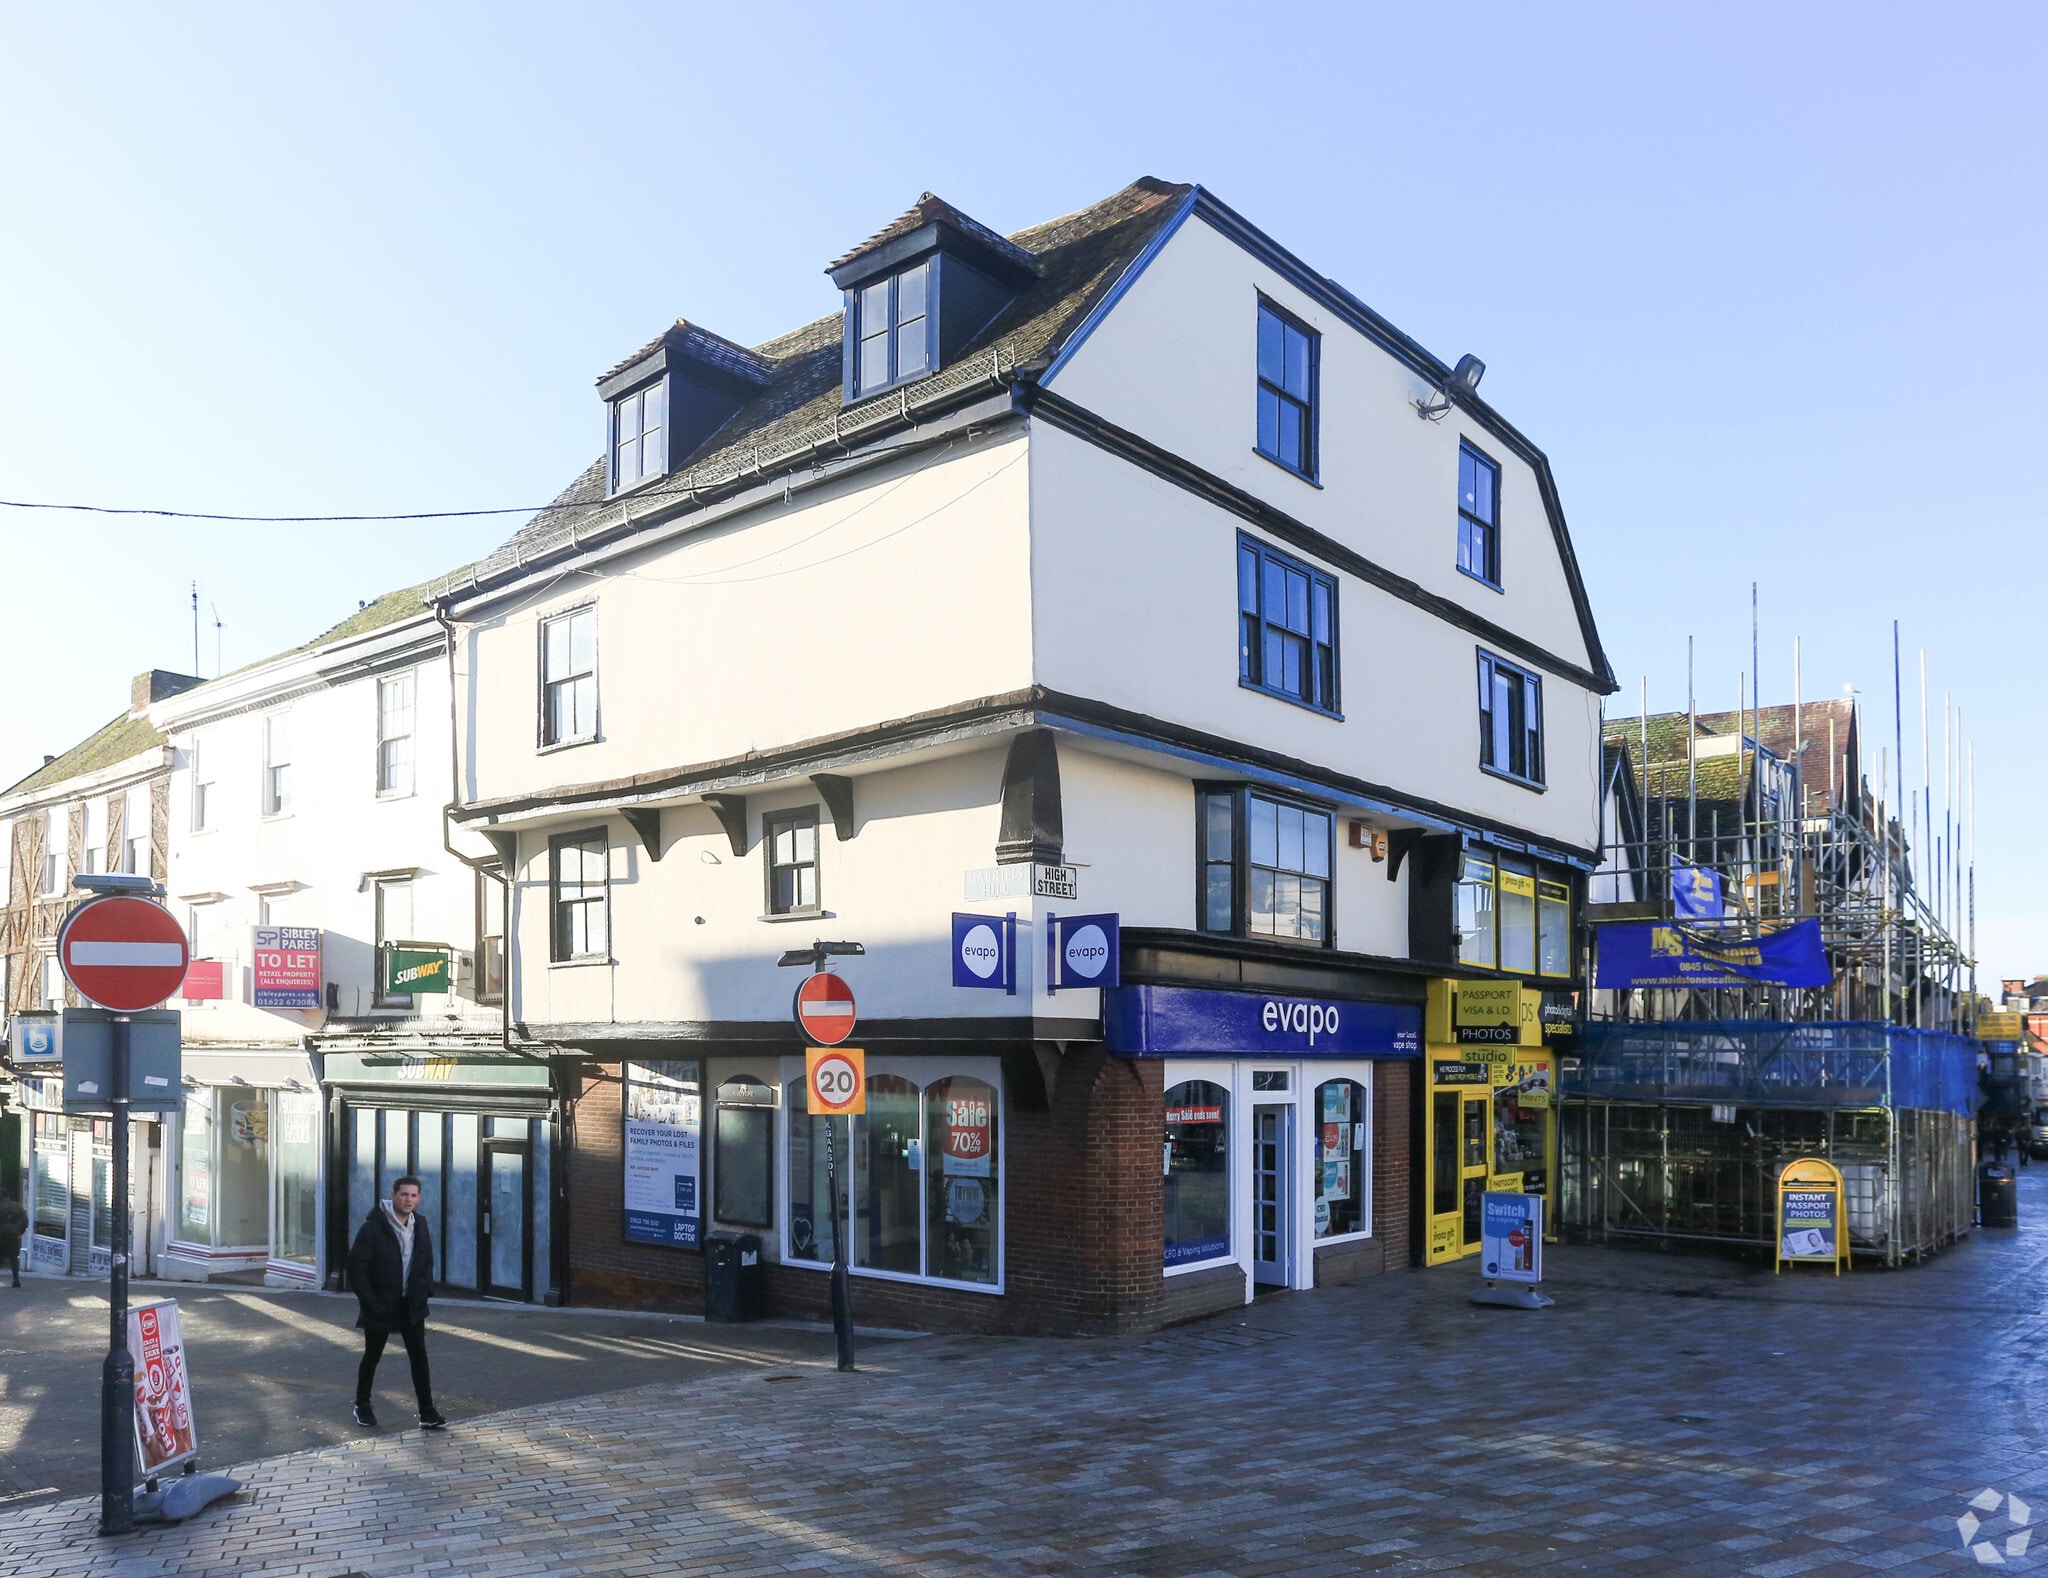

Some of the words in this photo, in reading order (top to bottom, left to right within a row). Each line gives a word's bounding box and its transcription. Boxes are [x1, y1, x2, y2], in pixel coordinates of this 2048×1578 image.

[968, 866, 1025, 882] GABRIELS
[1045, 867, 1067, 881] HIGH
[982, 883, 1009, 896] HILL
[1037, 880, 1074, 896] STREET
[282, 928, 317, 939] SIBLEY
[282, 940, 317, 950] PARES
[964, 946, 996, 960] evapo
[1068, 946, 1105, 960] evapo
[257, 954, 281, 968] TO
[287, 955, 317, 969] LET
[1680, 962, 1702, 972] 0845
[394, 960, 444, 985] SUBWAY
[1462, 990, 1512, 1000] PASSPORT
[1463, 1006, 1483, 1015] VISA
[1486, 1006, 1494, 1015] &
[1262, 1001, 1339, 1046] evapo
[1545, 1021, 1572, 1037] specialists
[1462, 1029, 1512, 1040] PHOTOS
[1393, 1041, 1405, 1050] vape
[1406, 1040, 1417, 1050] shop
[1465, 1050, 1507, 1062] studio
[397, 1057, 458, 1080] SUBWAY
[820, 1071, 852, 1093] 20
[1166, 1111, 1180, 1122] Hurry
[1194, 1110, 1205, 1120] ends
[630, 1127, 656, 1137] RECOVER
[656, 1129, 673, 1137] YOUR
[673, 1130, 688, 1138] LOST
[629, 1137, 648, 1145] FAMILY
[650, 1139, 672, 1148] PHOTOS
[673, 1140, 678, 1148] &
[679, 1140, 695, 1149] FILES
[952, 1132, 980, 1152] 70%
[1789, 1193, 1827, 1201] INSTANT
[1316, 1203, 1326, 1213] CBD
[1487, 1202, 1526, 1218] Switch
[1786, 1202, 1831, 1210] PASSPORT
[1790, 1210, 1827, 1218] PHOTOS
[674, 1223, 696, 1232] LAPTOP
[1497, 1218, 1519, 1226] vaping
[673, 1232, 696, 1241] DOCTOR
[1164, 1249, 1177, 1259] CBD
[1178, 1248, 1182, 1257] &
[1182, 1246, 1200, 1256] Vaping
[1201, 1242, 1225, 1253] solutions
